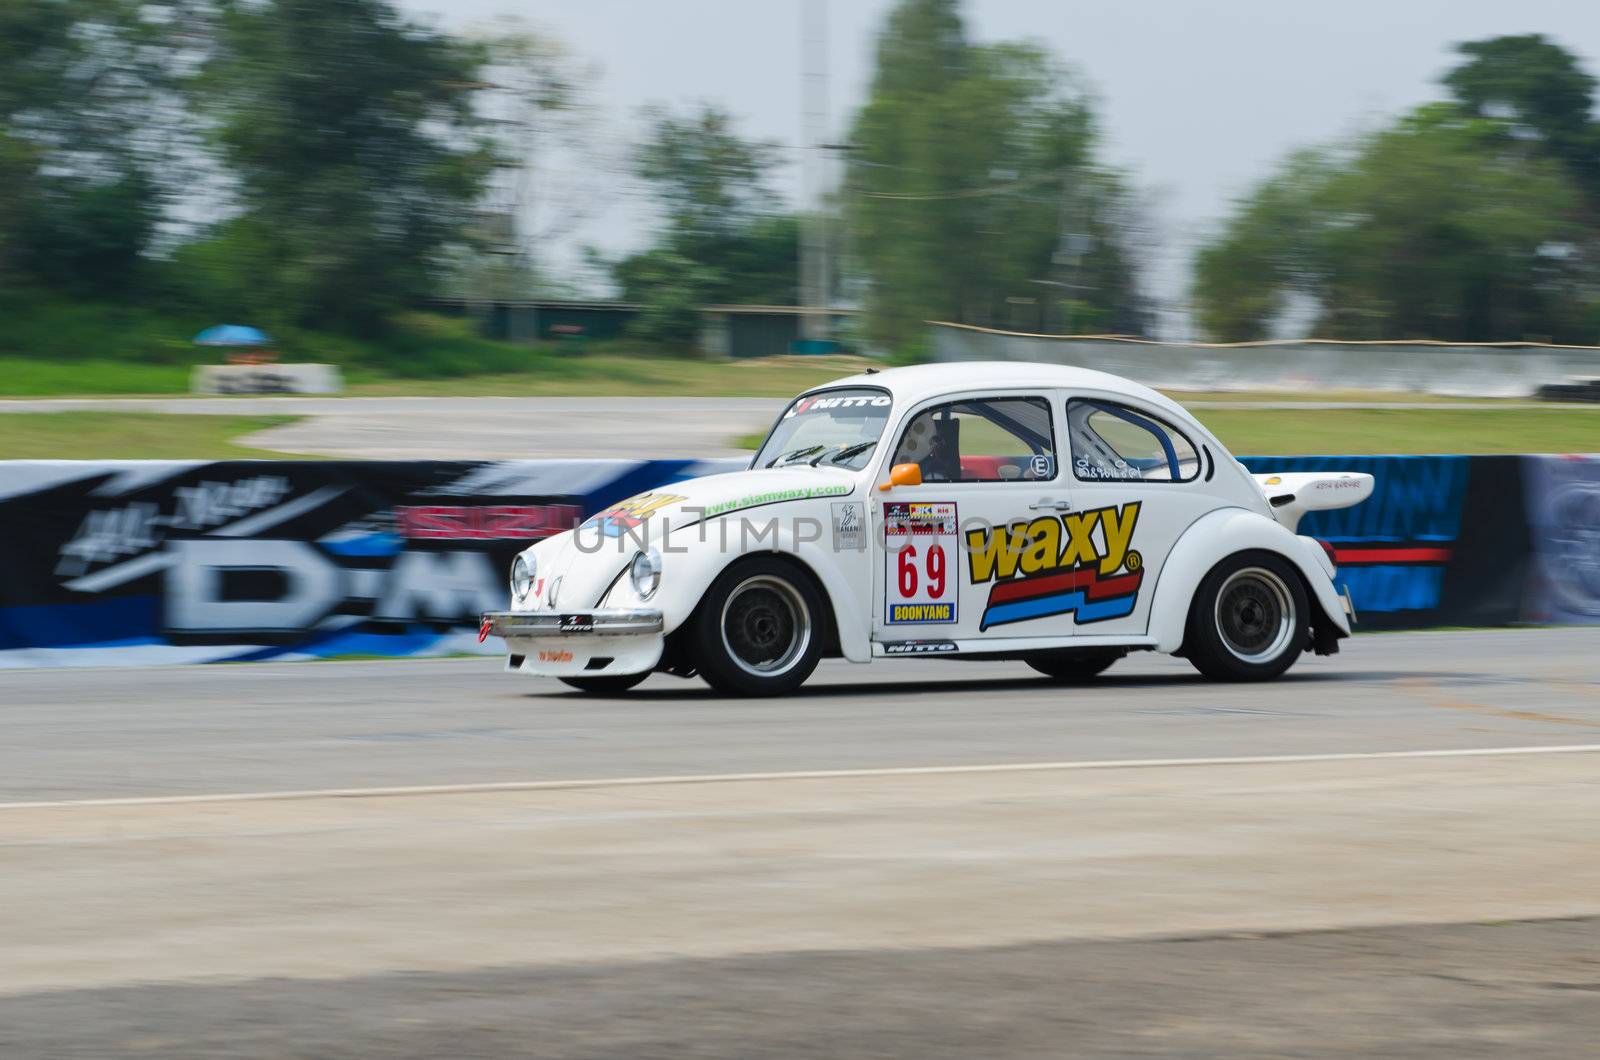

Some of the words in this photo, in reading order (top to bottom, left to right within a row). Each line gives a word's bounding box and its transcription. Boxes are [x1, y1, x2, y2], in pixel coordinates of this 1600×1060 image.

[808, 396, 892, 411] NITTO
[965, 501, 1142, 585] waxy
[897, 544, 946, 600] 69
[894, 604, 950, 621] BOONYANG
[887, 643, 955, 653] NITTO
